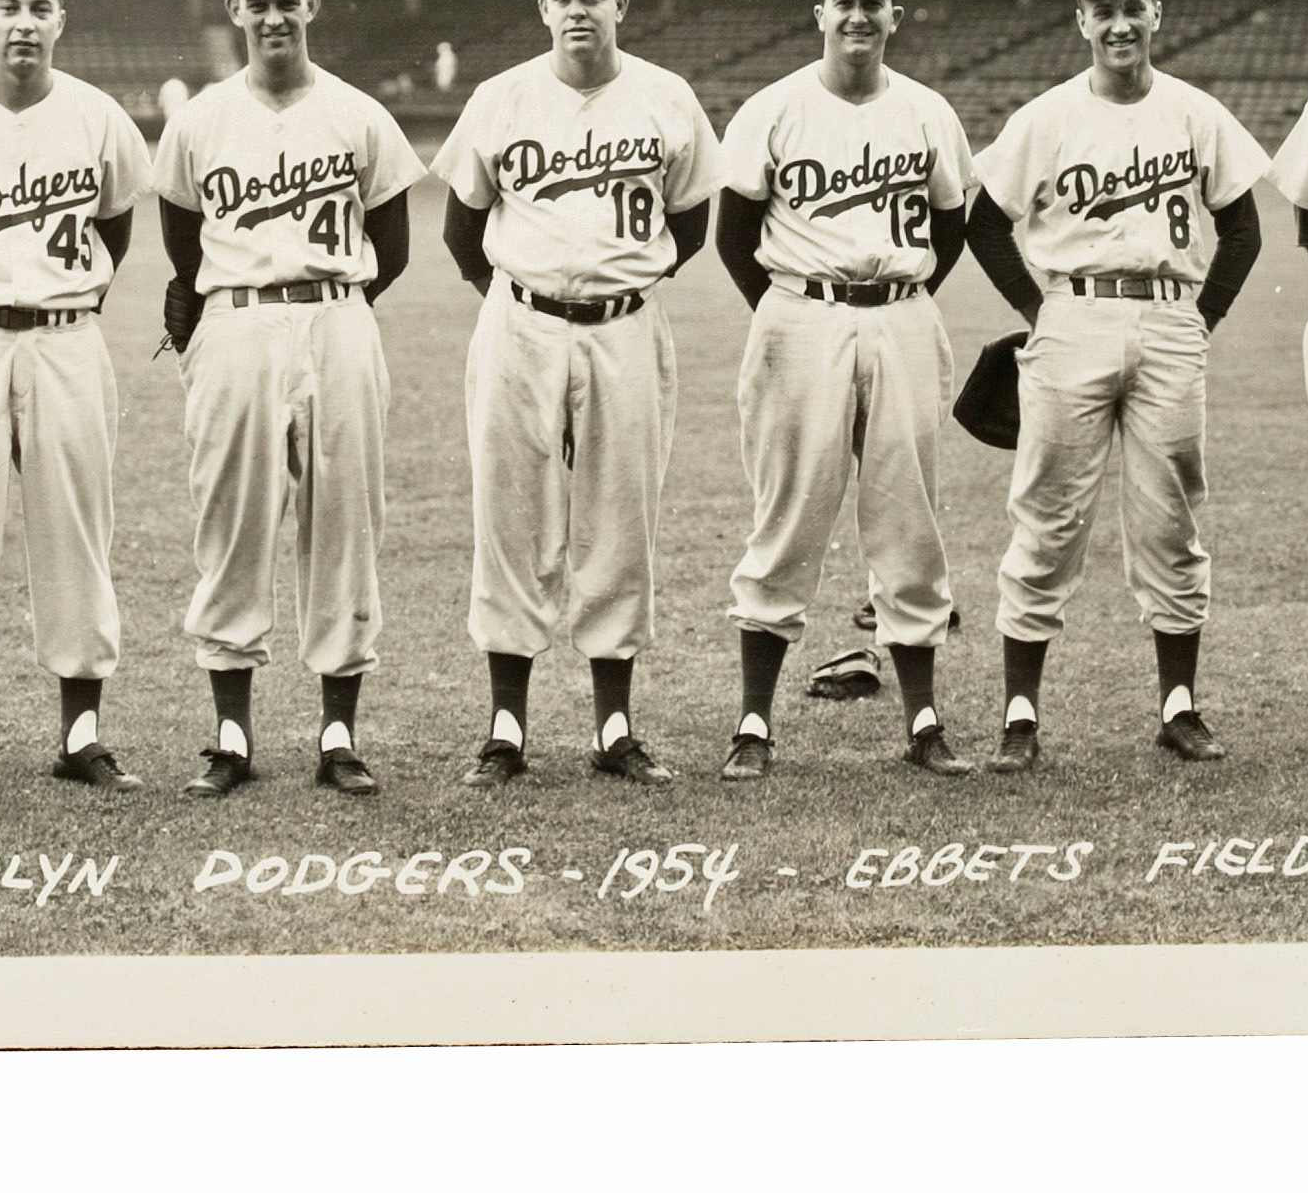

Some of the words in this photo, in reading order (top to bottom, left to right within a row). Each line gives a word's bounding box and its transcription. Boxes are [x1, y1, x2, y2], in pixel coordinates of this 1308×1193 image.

[202, 151, 357, 229] Dodgers
[500, 128, 663, 206] Dodgers
[307, 200, 353, 257] 41
[611, 181, 653, 243] 18
[887, 193, 931, 248] 12
[1163, 193, 1191, 249] 8
